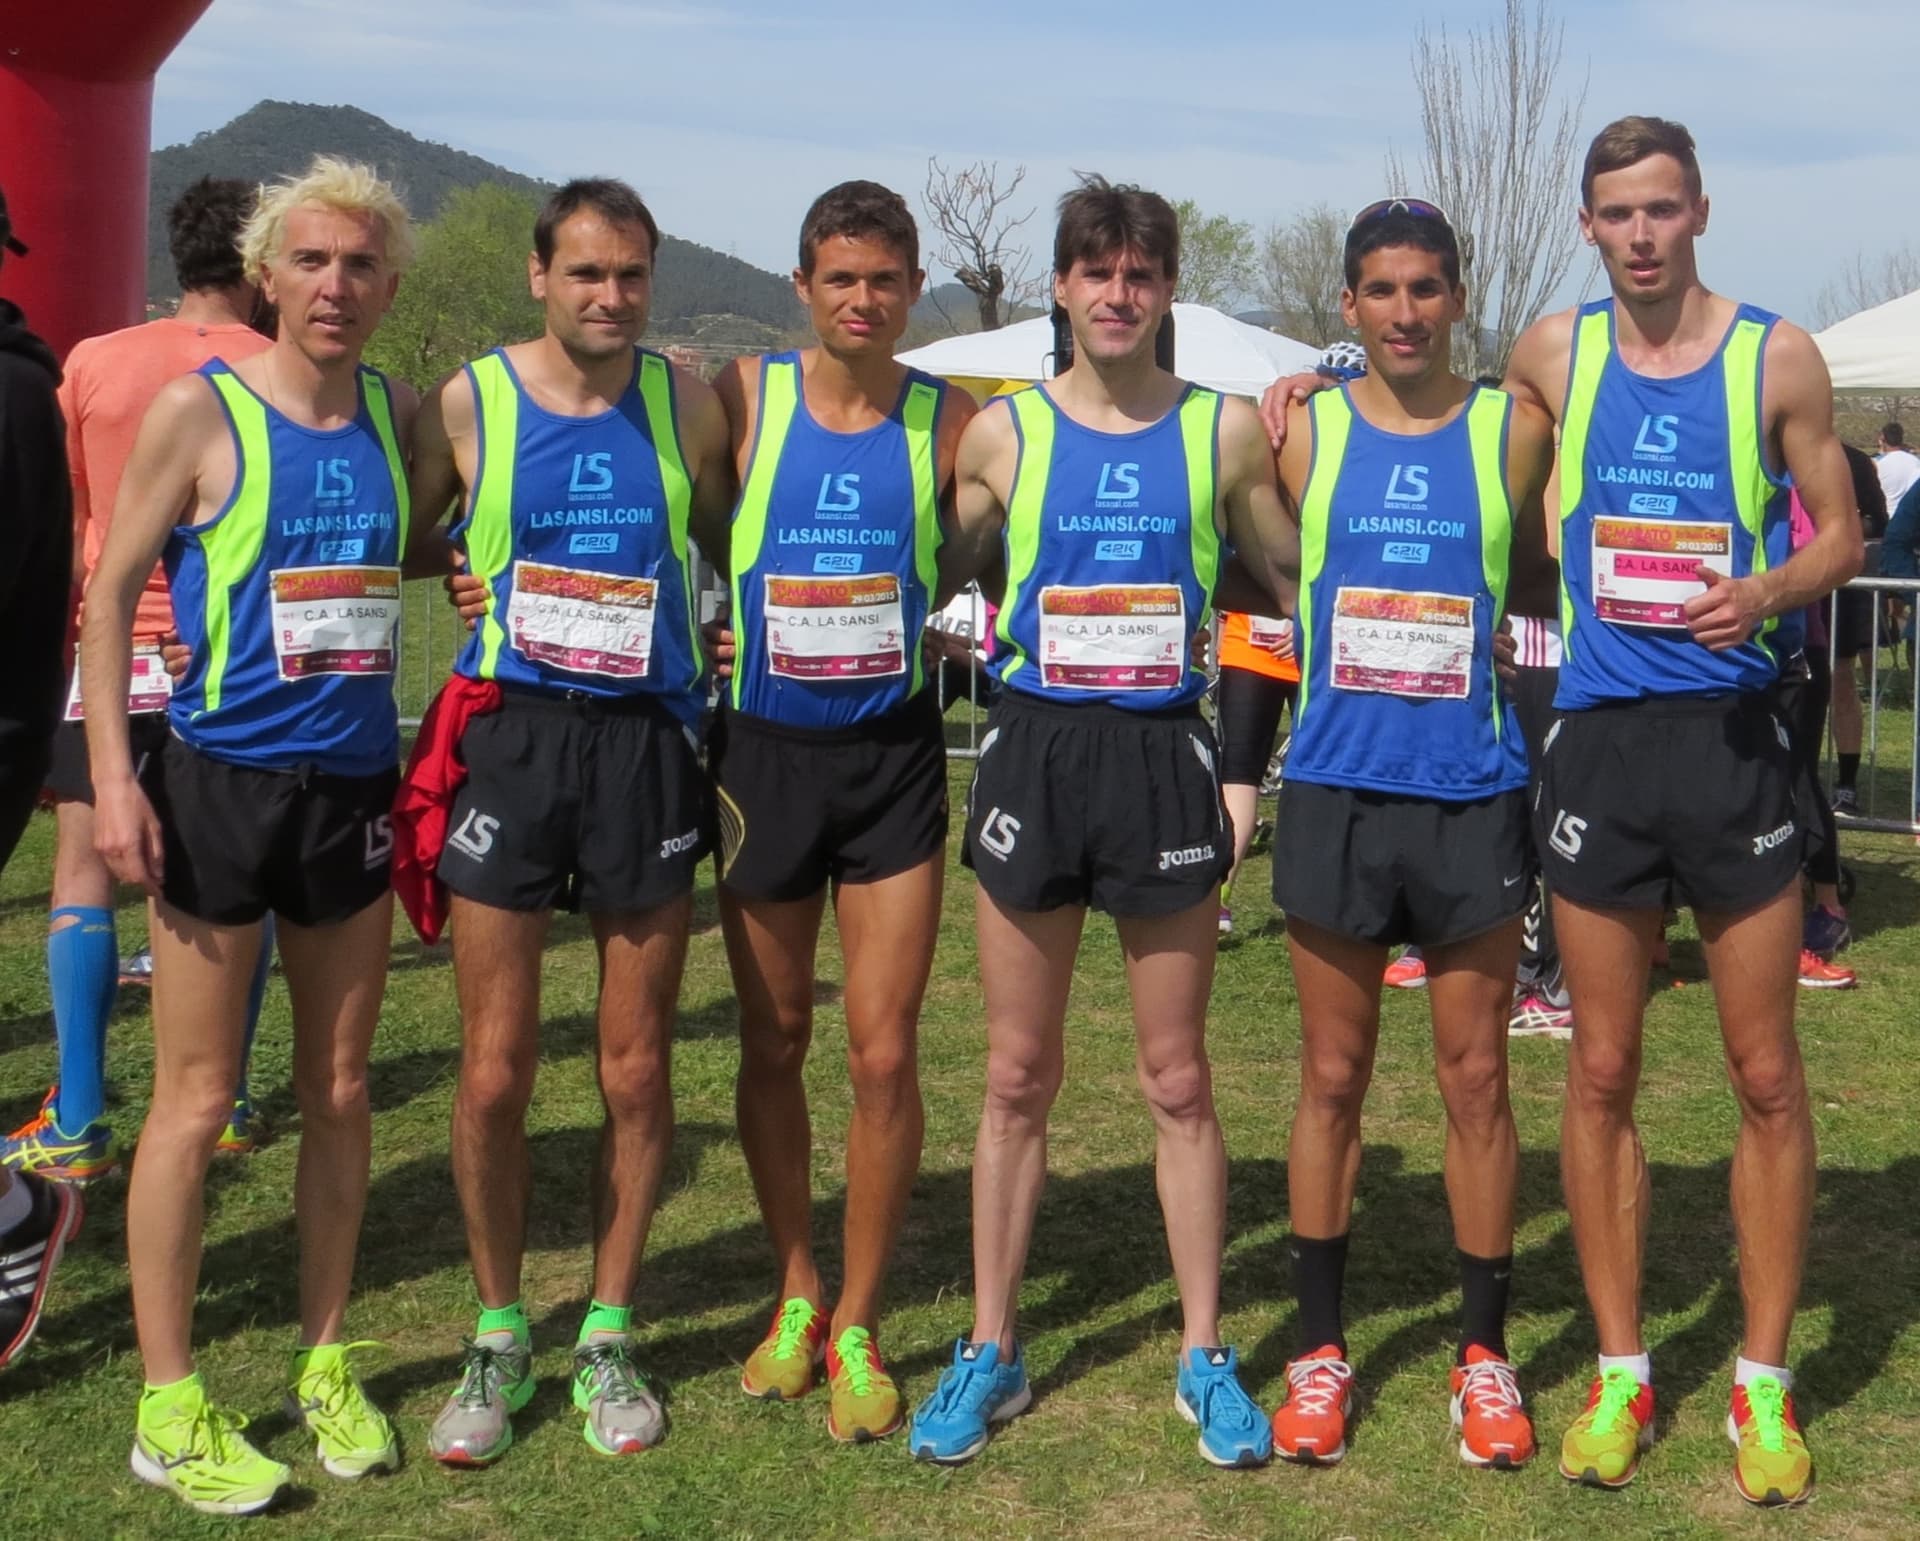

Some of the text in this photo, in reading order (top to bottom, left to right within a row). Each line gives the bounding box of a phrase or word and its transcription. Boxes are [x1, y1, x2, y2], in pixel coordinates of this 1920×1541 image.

[1634, 414, 1679, 454] LS
[315, 458, 354, 498] LS
[569, 452, 613, 492] LS
[1597, 465, 1715, 490] LASANSI.COM
[1096, 462, 1140, 500] LS
[1385, 464, 1429, 502] LS
[816, 473, 860, 512] LS
[1635, 497, 1671, 508] 42K
[282, 513, 391, 536] LASANSI.COM
[530, 508, 653, 528] LASANSI.COM
[1058, 515, 1177, 534] LASANSI.COM
[1349, 516, 1465, 539] LASANSI.COM
[575, 536, 612, 547] 42K
[778, 528, 896, 545] LASANSI.COM
[1101, 543, 1136, 554] 42K
[1389, 546, 1423, 557] 42K
[819, 556, 856, 566] 42K
[1641, 560, 1658, 572] LA
[1662, 562, 1697, 574] SANS
[338, 608, 354, 618] LA
[357, 607, 387, 618] SANSI
[567, 607, 583, 617] LA
[818, 616, 835, 627] LA
[839, 614, 880, 626] SANSI
[283, 630, 293, 642] B
[1096, 624, 1113, 635] LA
[1118, 624, 1158, 636] SANSI
[1386, 630, 1403, 642] LA
[1407, 632, 1448, 644] SANSI
[1048, 640, 1056, 652] B
[1339, 642, 1348, 654] B
[450, 807, 500, 855] LS
[980, 806, 1021, 854] LS
[1551, 809, 1588, 855] LS
